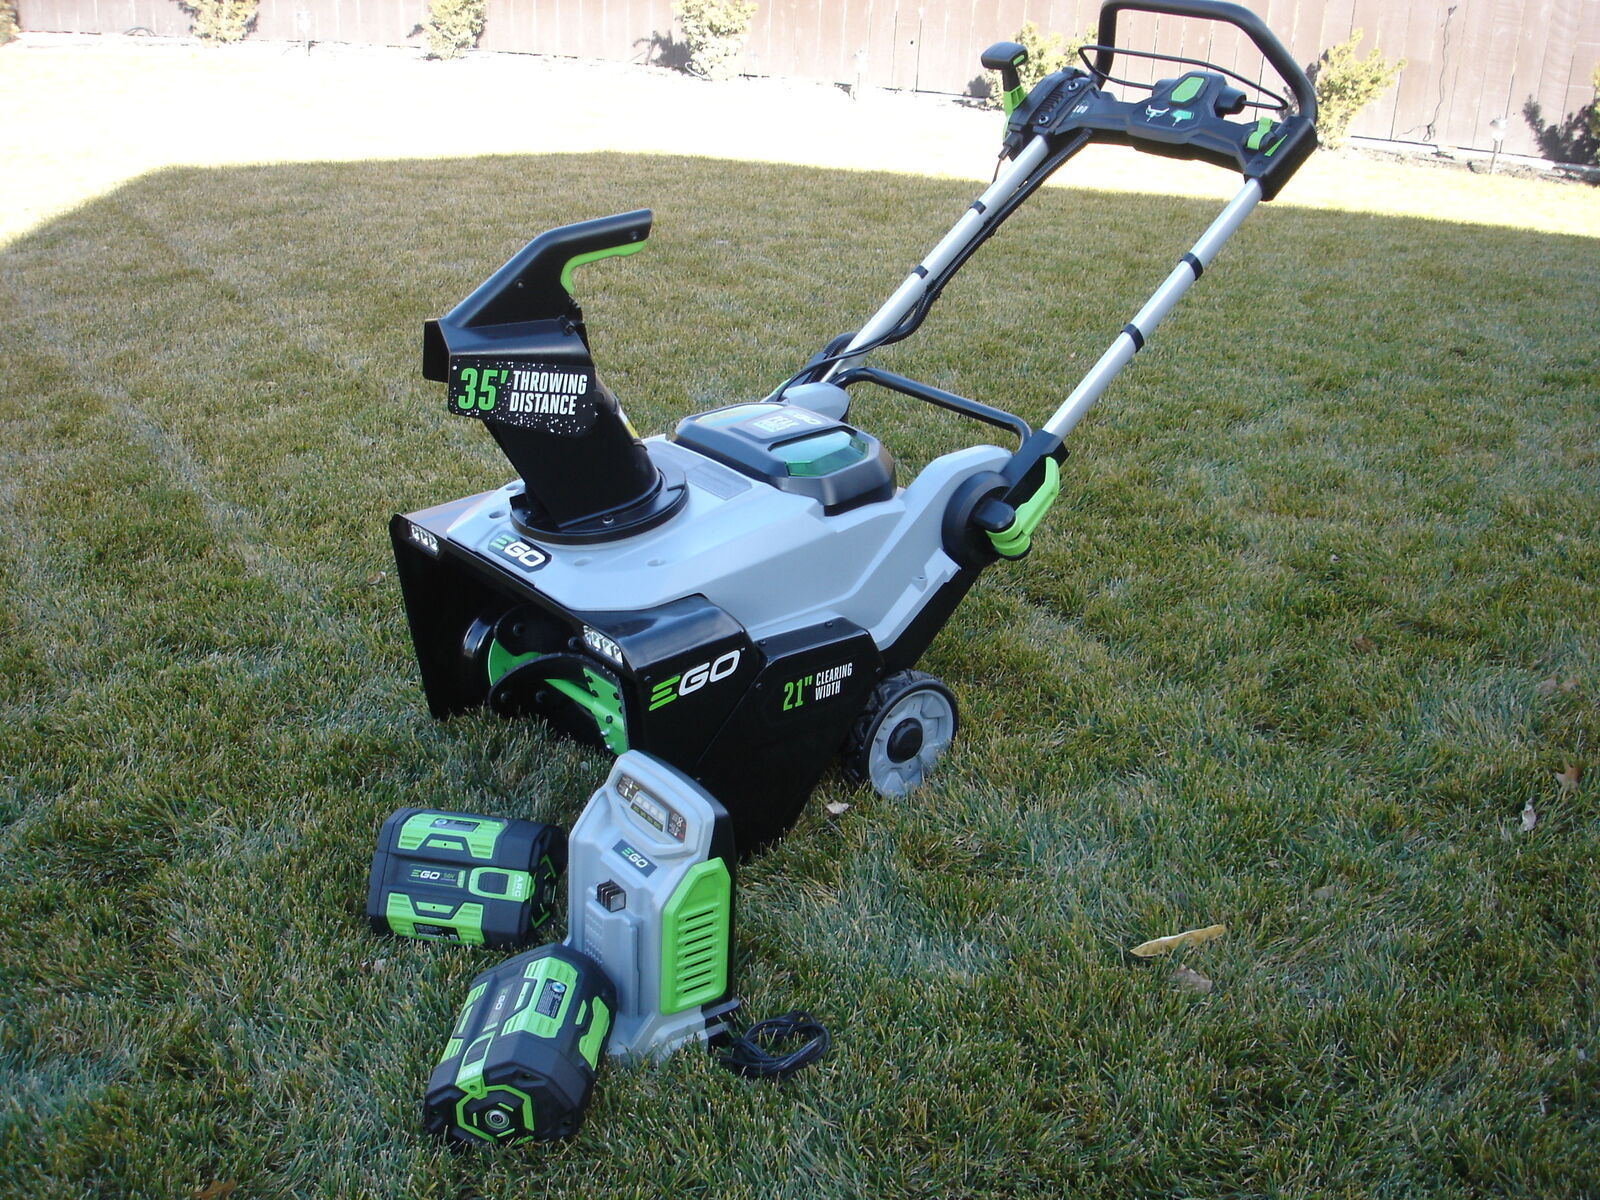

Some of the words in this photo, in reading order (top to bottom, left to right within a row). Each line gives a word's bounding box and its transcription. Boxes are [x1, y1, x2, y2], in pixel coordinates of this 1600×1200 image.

[457, 367, 509, 411] 35'
[512, 370, 588, 395] THROWING
[509, 391, 578, 416] DISTANCE
[490, 534, 546, 567] EGO
[649, 649, 741, 711] EGO
[783, 675, 813, 711] 21"
[815, 662, 853, 687] CLEARING
[815, 681, 841, 701] WIDTH
[621, 847, 649, 869] EGO
[410, 869, 441, 880] EGO
